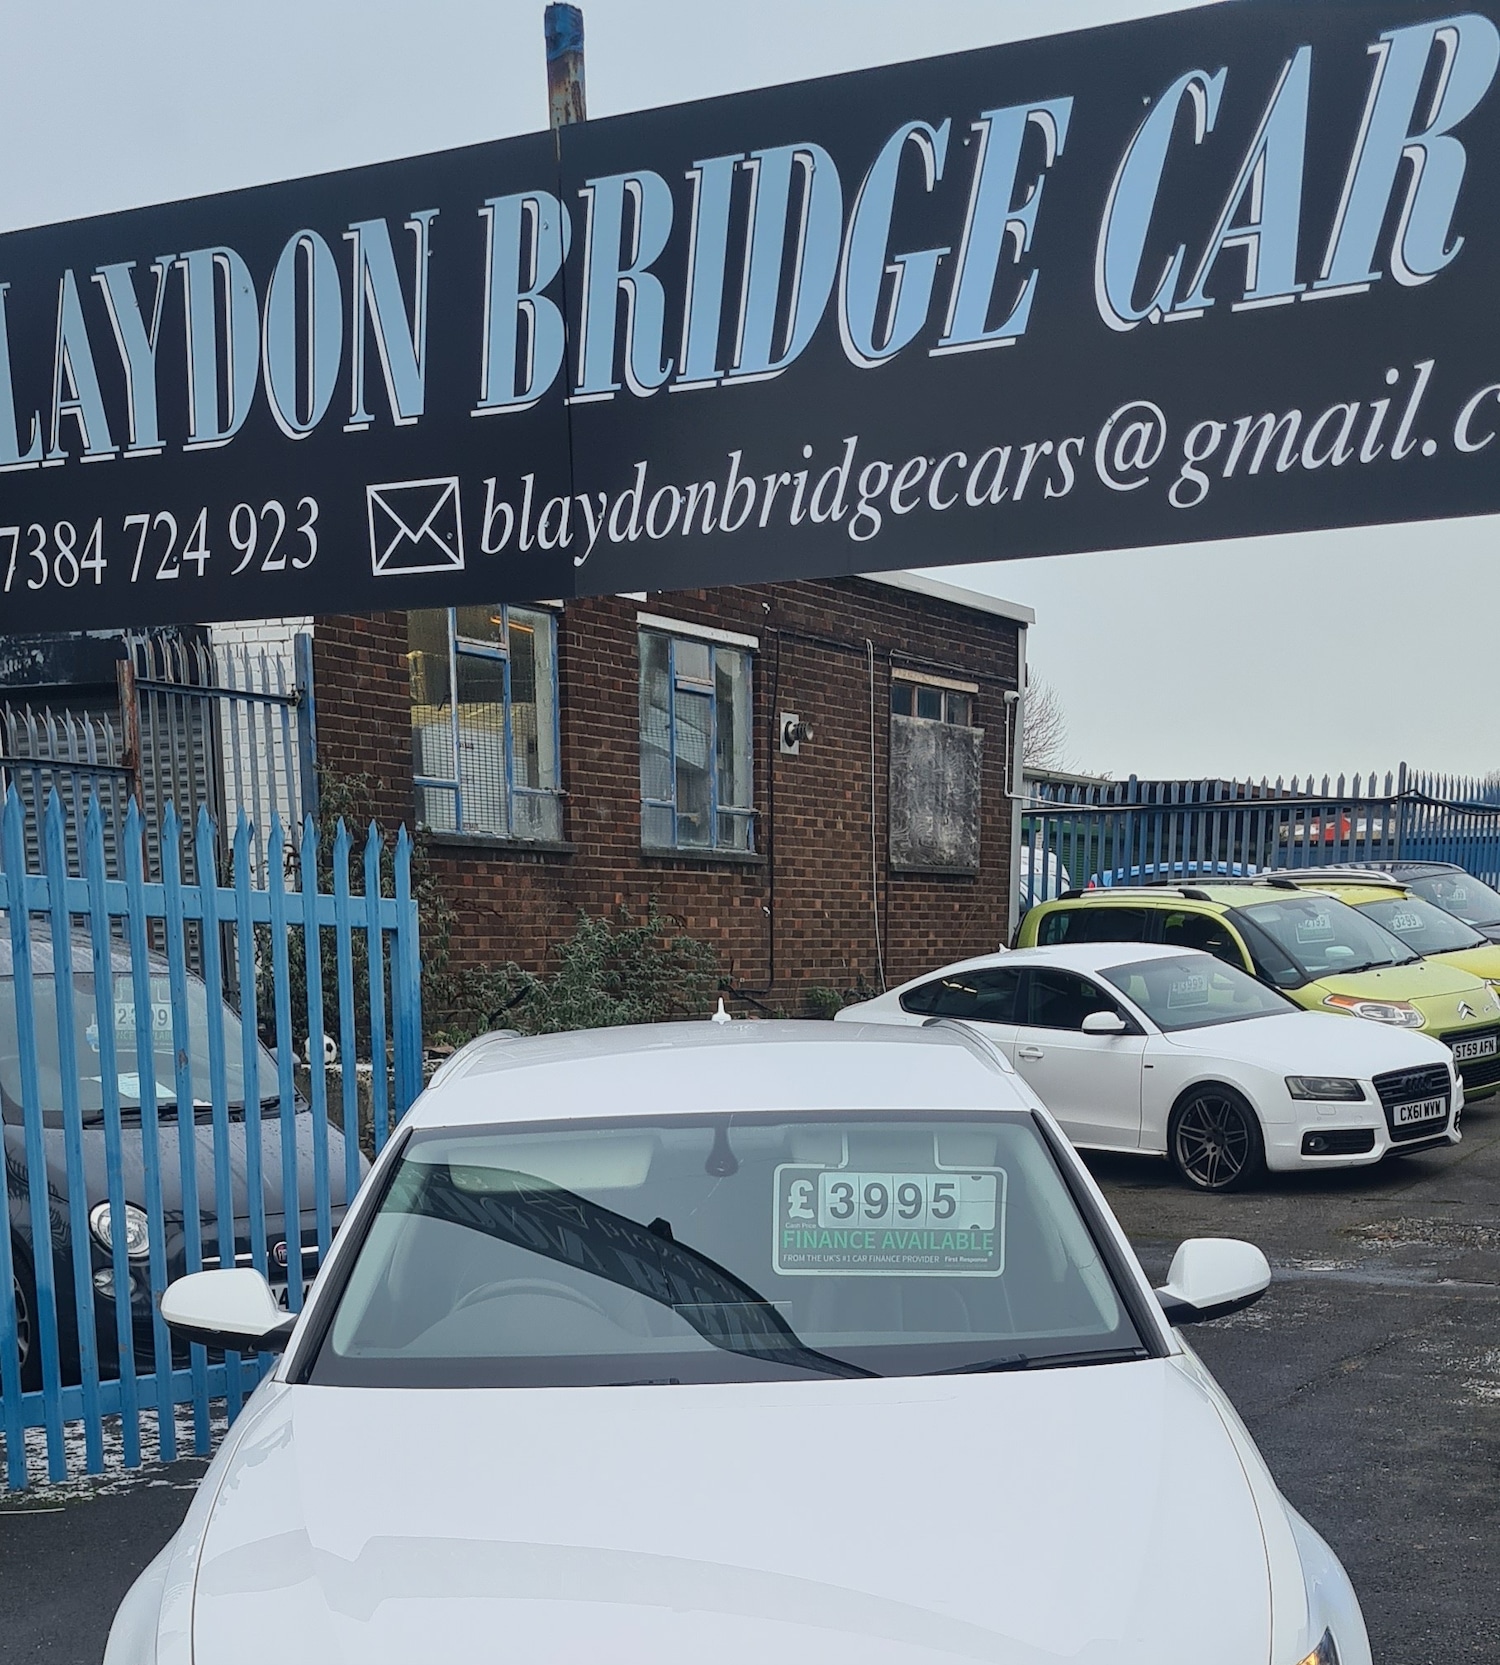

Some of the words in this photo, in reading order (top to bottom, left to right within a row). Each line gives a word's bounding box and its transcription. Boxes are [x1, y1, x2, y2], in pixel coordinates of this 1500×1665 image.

[470, 96, 1075, 416] BRIDGE
[1094, 13, 1500, 332] CAR
[122, 506, 211, 582] 724
[228, 496, 320, 576] 923
[1455, 1042, 1478, 1058] ST59
[1479, 1039, 1494, 1055] AFN
[1400, 1103, 1422, 1121] CX61
[783, 1230, 876, 1249] FINANCE
[881, 1231, 994, 1251] AVAILABLE
[783, 1253, 805, 1262] FROM
[807, 1254, 821, 1262] THE
[823, 1254, 841, 1263] UK'S
[842, 1254, 850, 1263] #1
[852, 1254, 867, 1263] CAR
[868, 1254, 901, 1263] FINANCE
[902, 1255, 940, 1264] PROVIDER
[959, 1256, 988, 1264] Response
